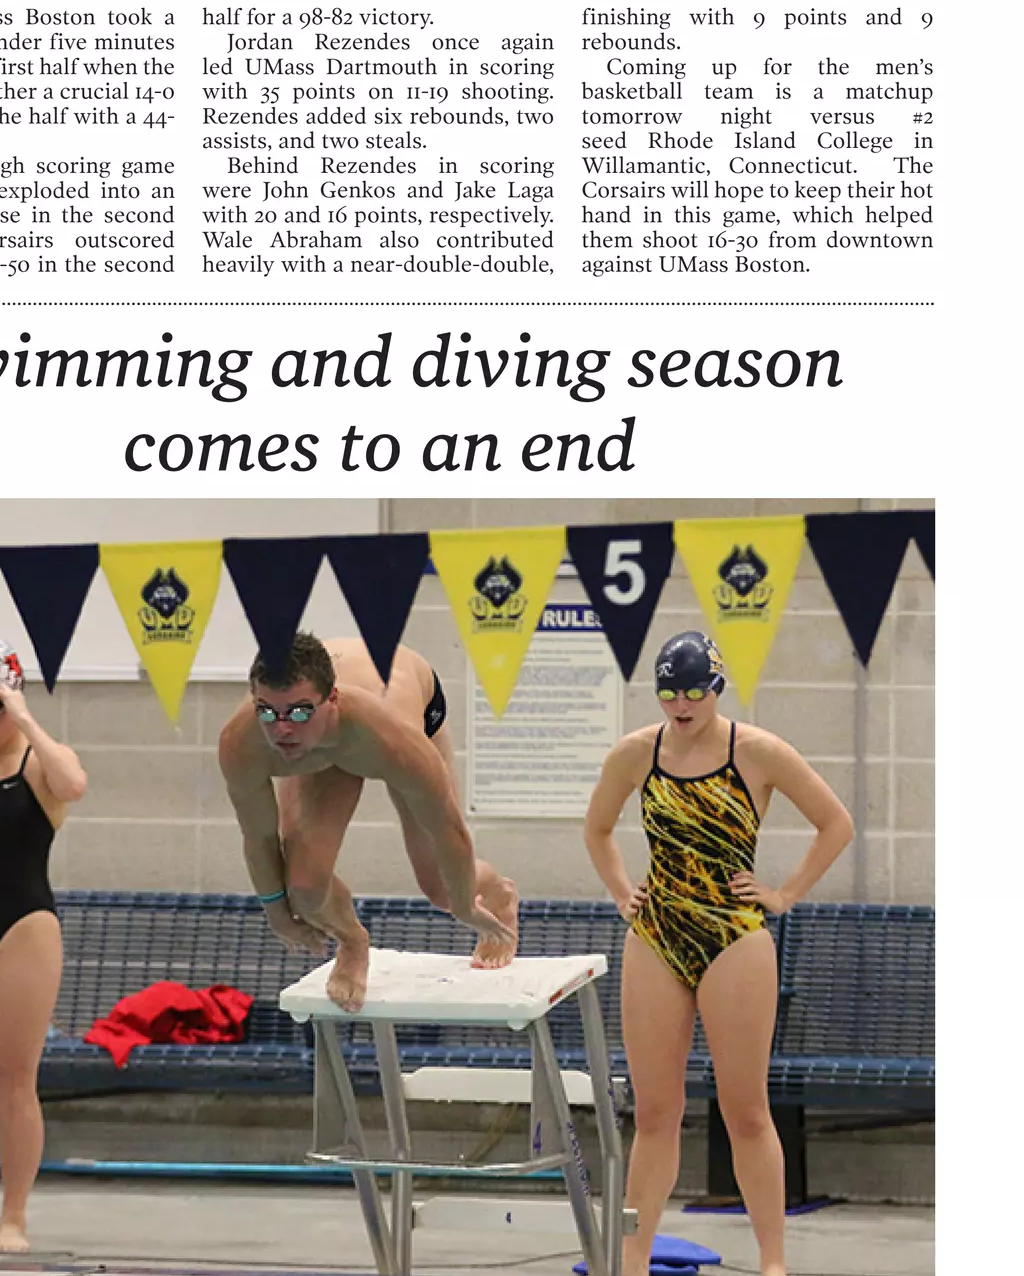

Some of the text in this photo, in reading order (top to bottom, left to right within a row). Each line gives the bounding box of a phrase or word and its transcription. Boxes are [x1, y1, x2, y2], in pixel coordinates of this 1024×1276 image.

[26, 9, 95, 25] Boston
[108, 8, 152, 25] took
[165, 13, 174, 25] a
[227, 32, 554, 54] Jordan Rezendes once again
[582, 256, 809, 277] against UMass Boston.
[272, 332, 392, 387] and
[413, 332, 611, 402] diving
[628, 350, 843, 387] season
[125, 416, 636, 472] comes to an end
[603, 539, 646, 605] 5
